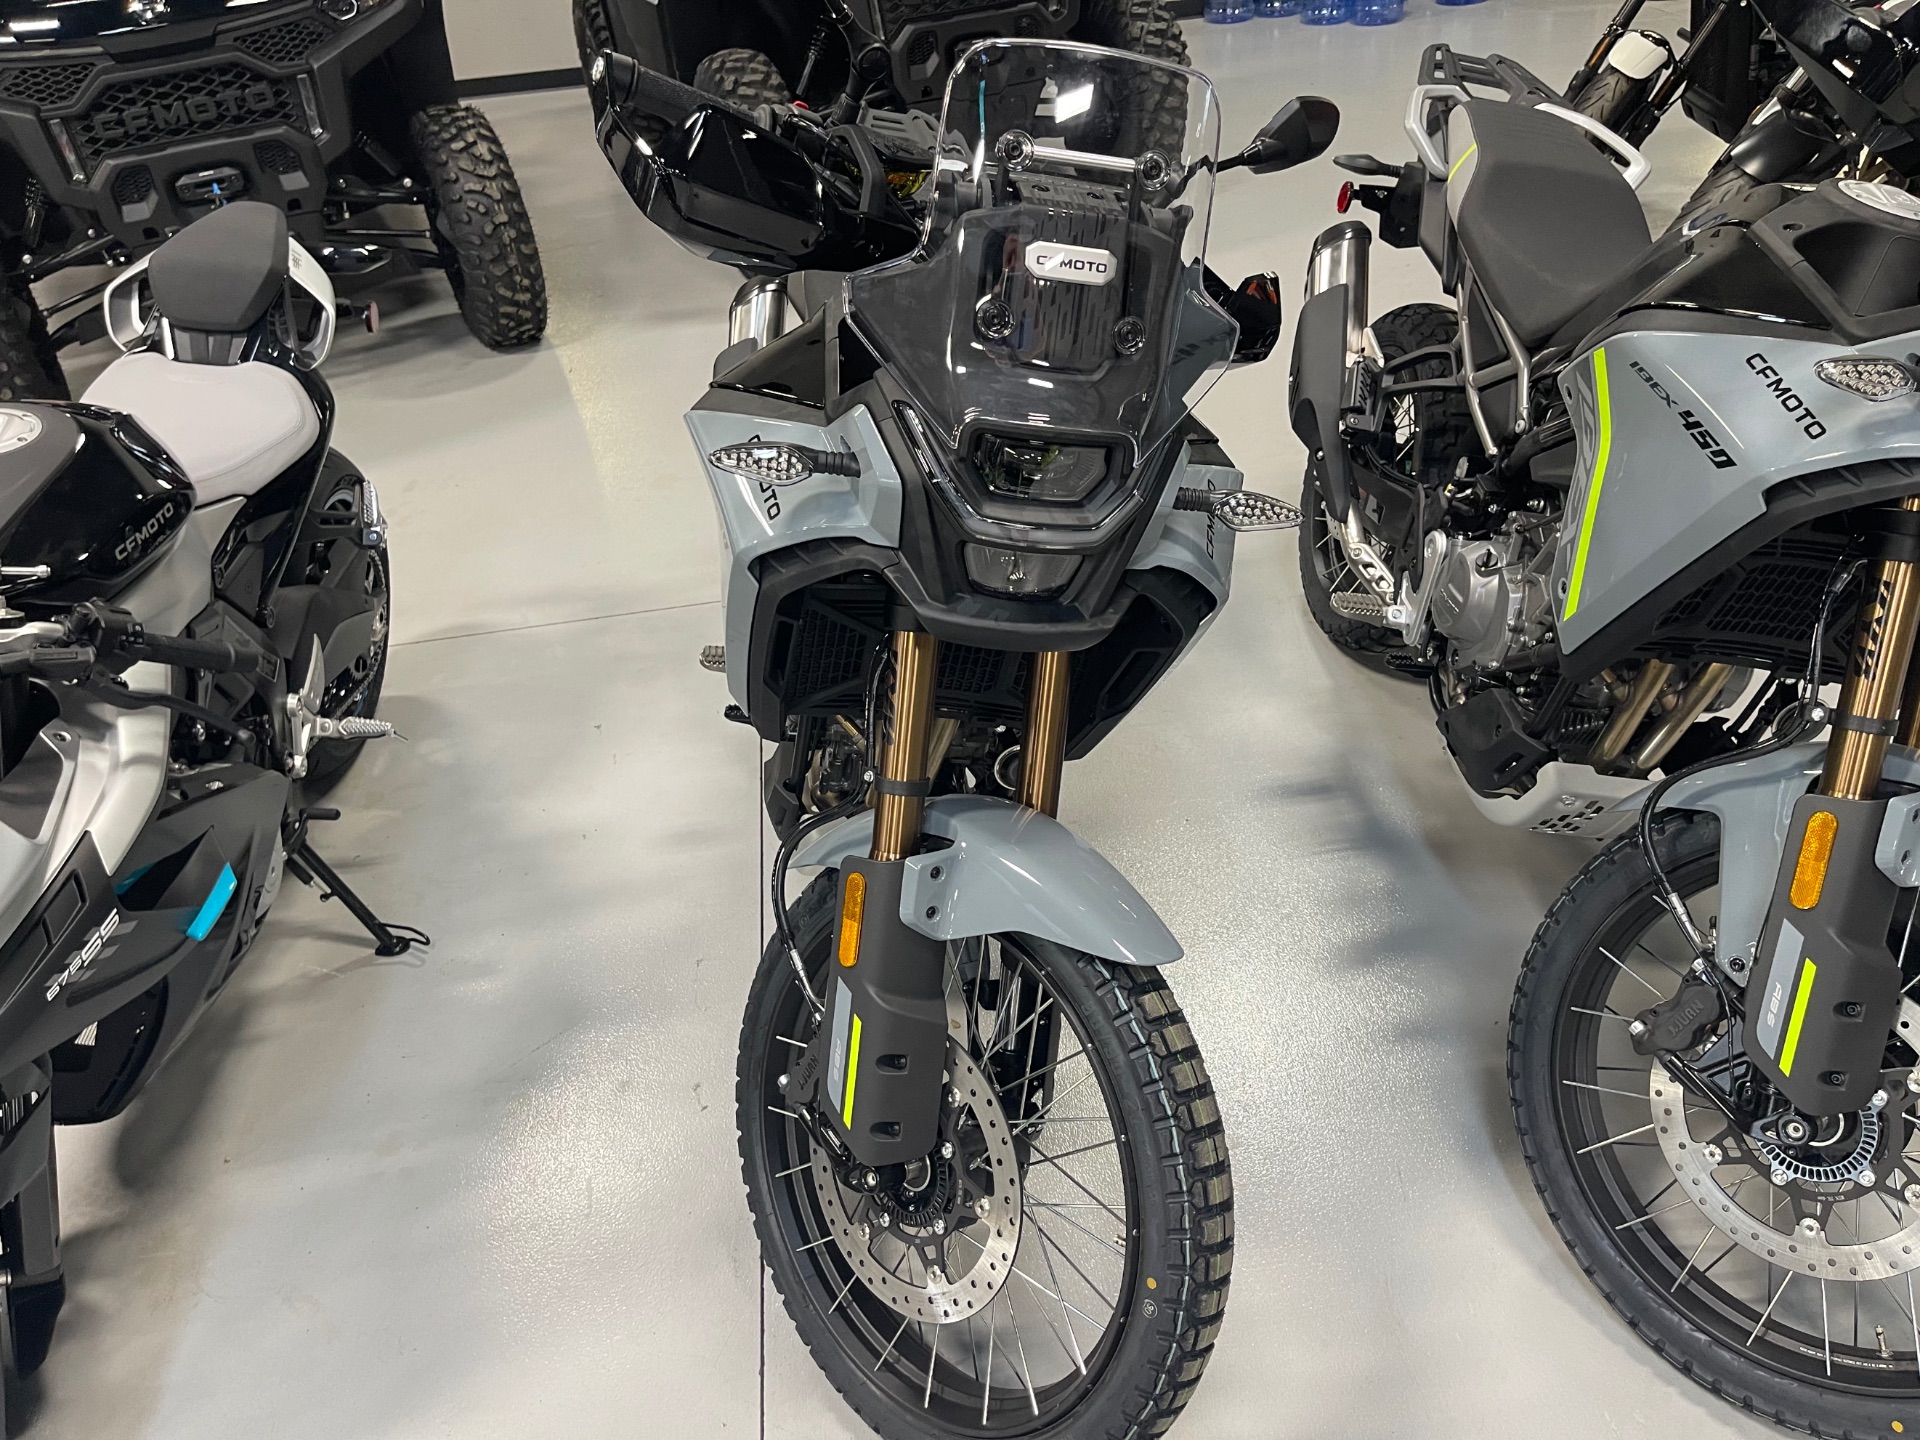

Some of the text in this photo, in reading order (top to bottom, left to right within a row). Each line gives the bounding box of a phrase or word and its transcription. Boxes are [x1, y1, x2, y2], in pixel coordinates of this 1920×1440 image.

[93, 80, 275, 139] CFMOTO
[1036, 255, 1108, 274] CMOTO
[1629, 360, 1738, 470] IBEX 450
[1745, 352, 1827, 440] CFMOTO
[115, 502, 174, 560] CFMOTO
[46, 907, 120, 1002] 675SS
[1767, 981, 1783, 1028] ABS
